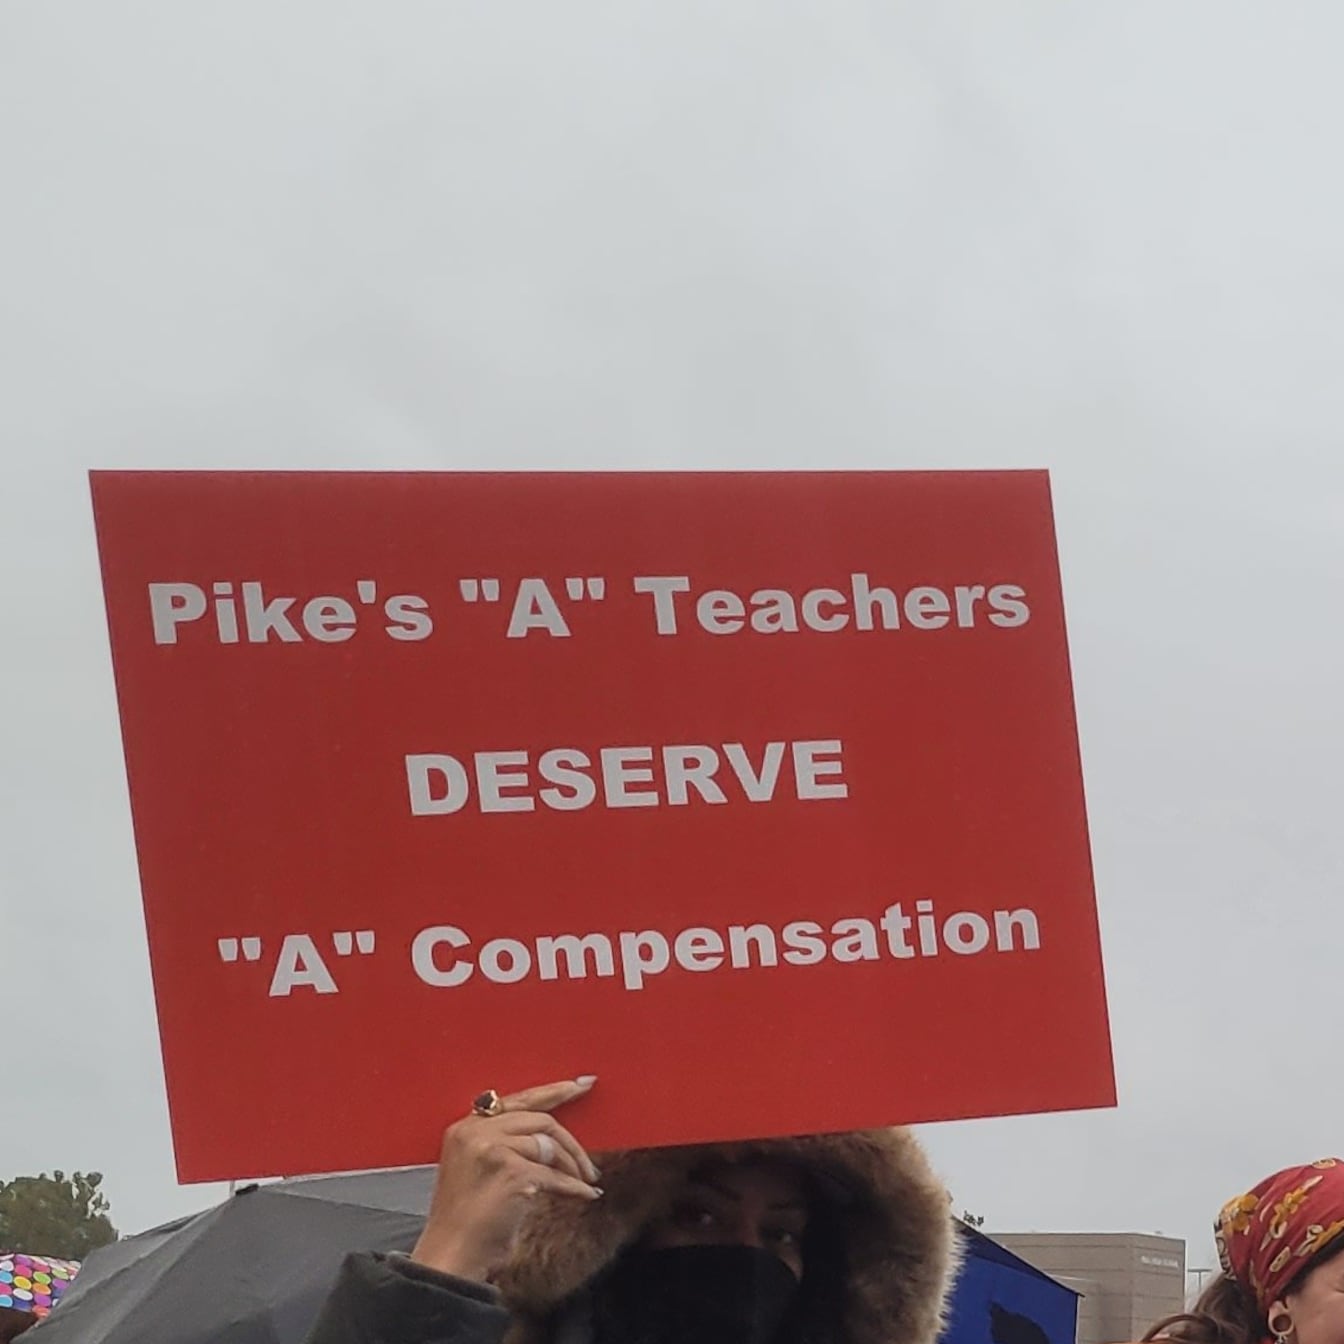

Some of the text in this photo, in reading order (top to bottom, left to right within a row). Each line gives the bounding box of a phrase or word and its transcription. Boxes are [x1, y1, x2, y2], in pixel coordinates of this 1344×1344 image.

[149, 572, 1031, 645] Pike's "A" Teachers
[405, 739, 848, 816] DESERVE
[218, 899, 1041, 997] "A" Compensation
